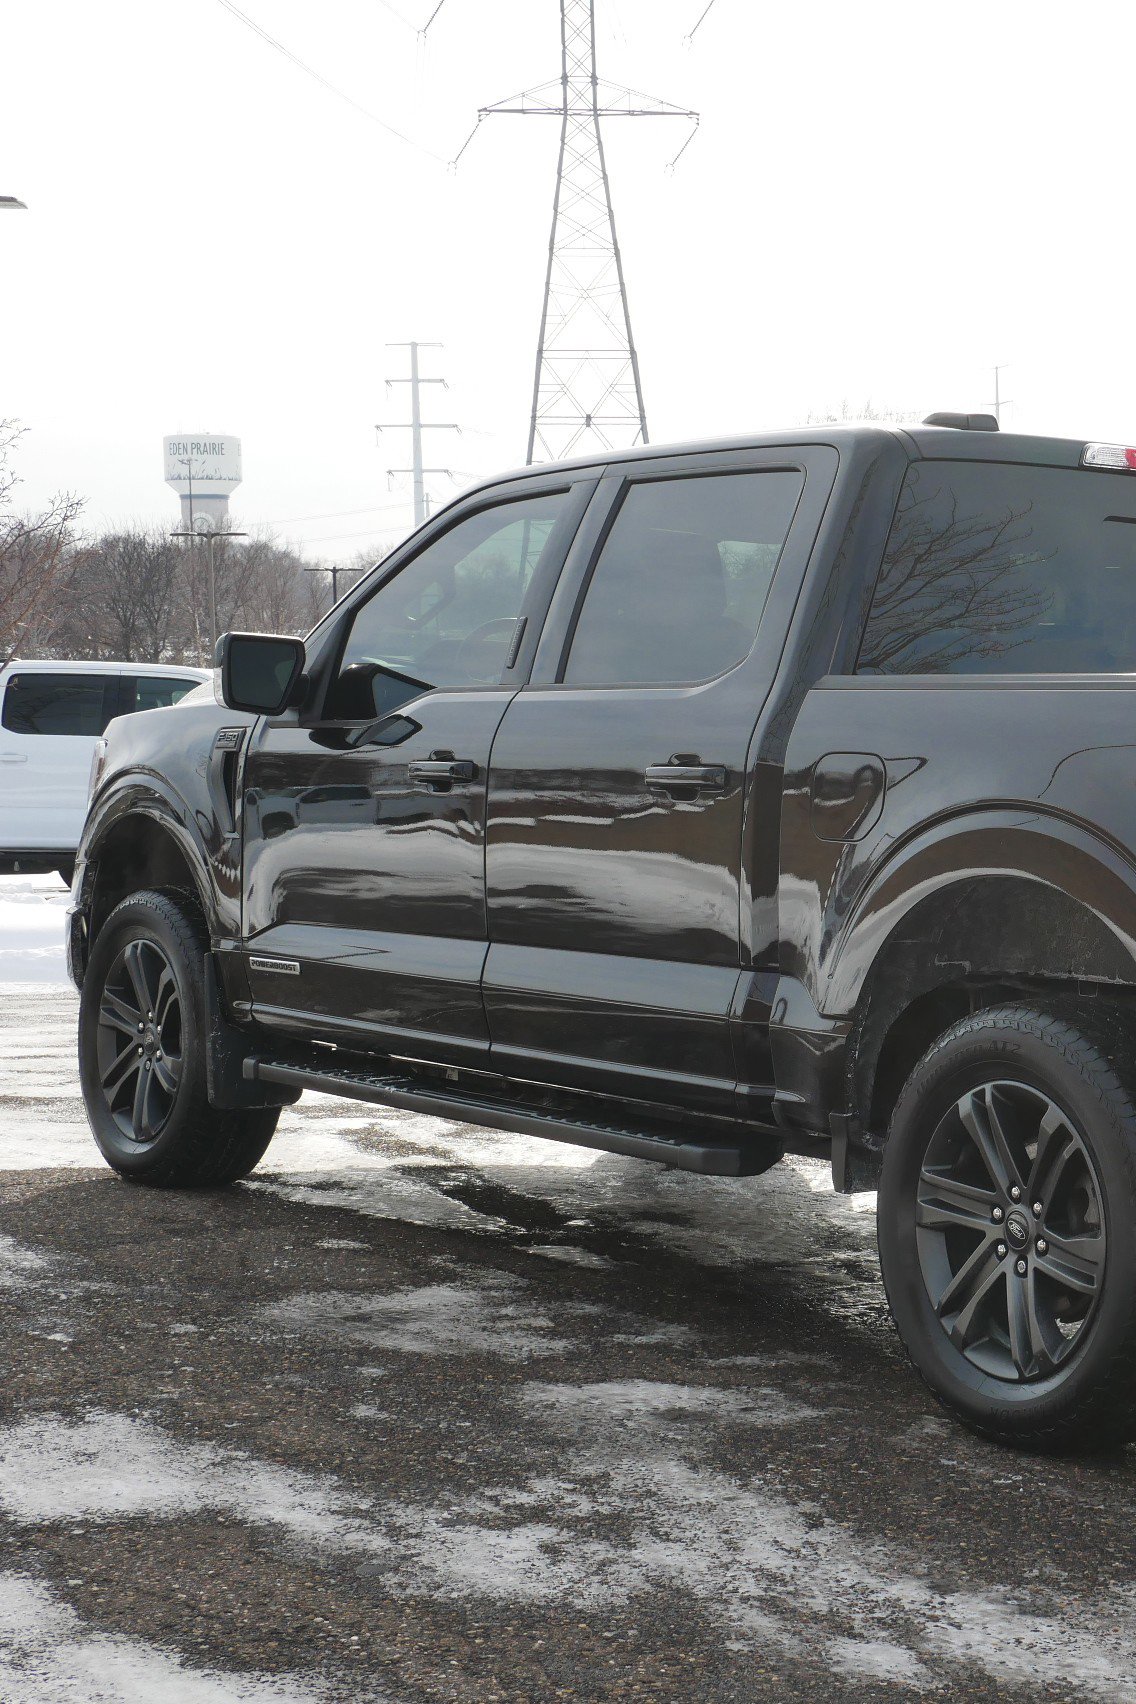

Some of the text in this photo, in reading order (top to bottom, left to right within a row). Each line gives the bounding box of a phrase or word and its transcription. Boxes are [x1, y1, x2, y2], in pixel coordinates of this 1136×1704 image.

[169, 443, 188, 456] EDEN
[190, 442, 226, 456] PRAIRIE
[251, 960, 297, 971] POWERBOOST
